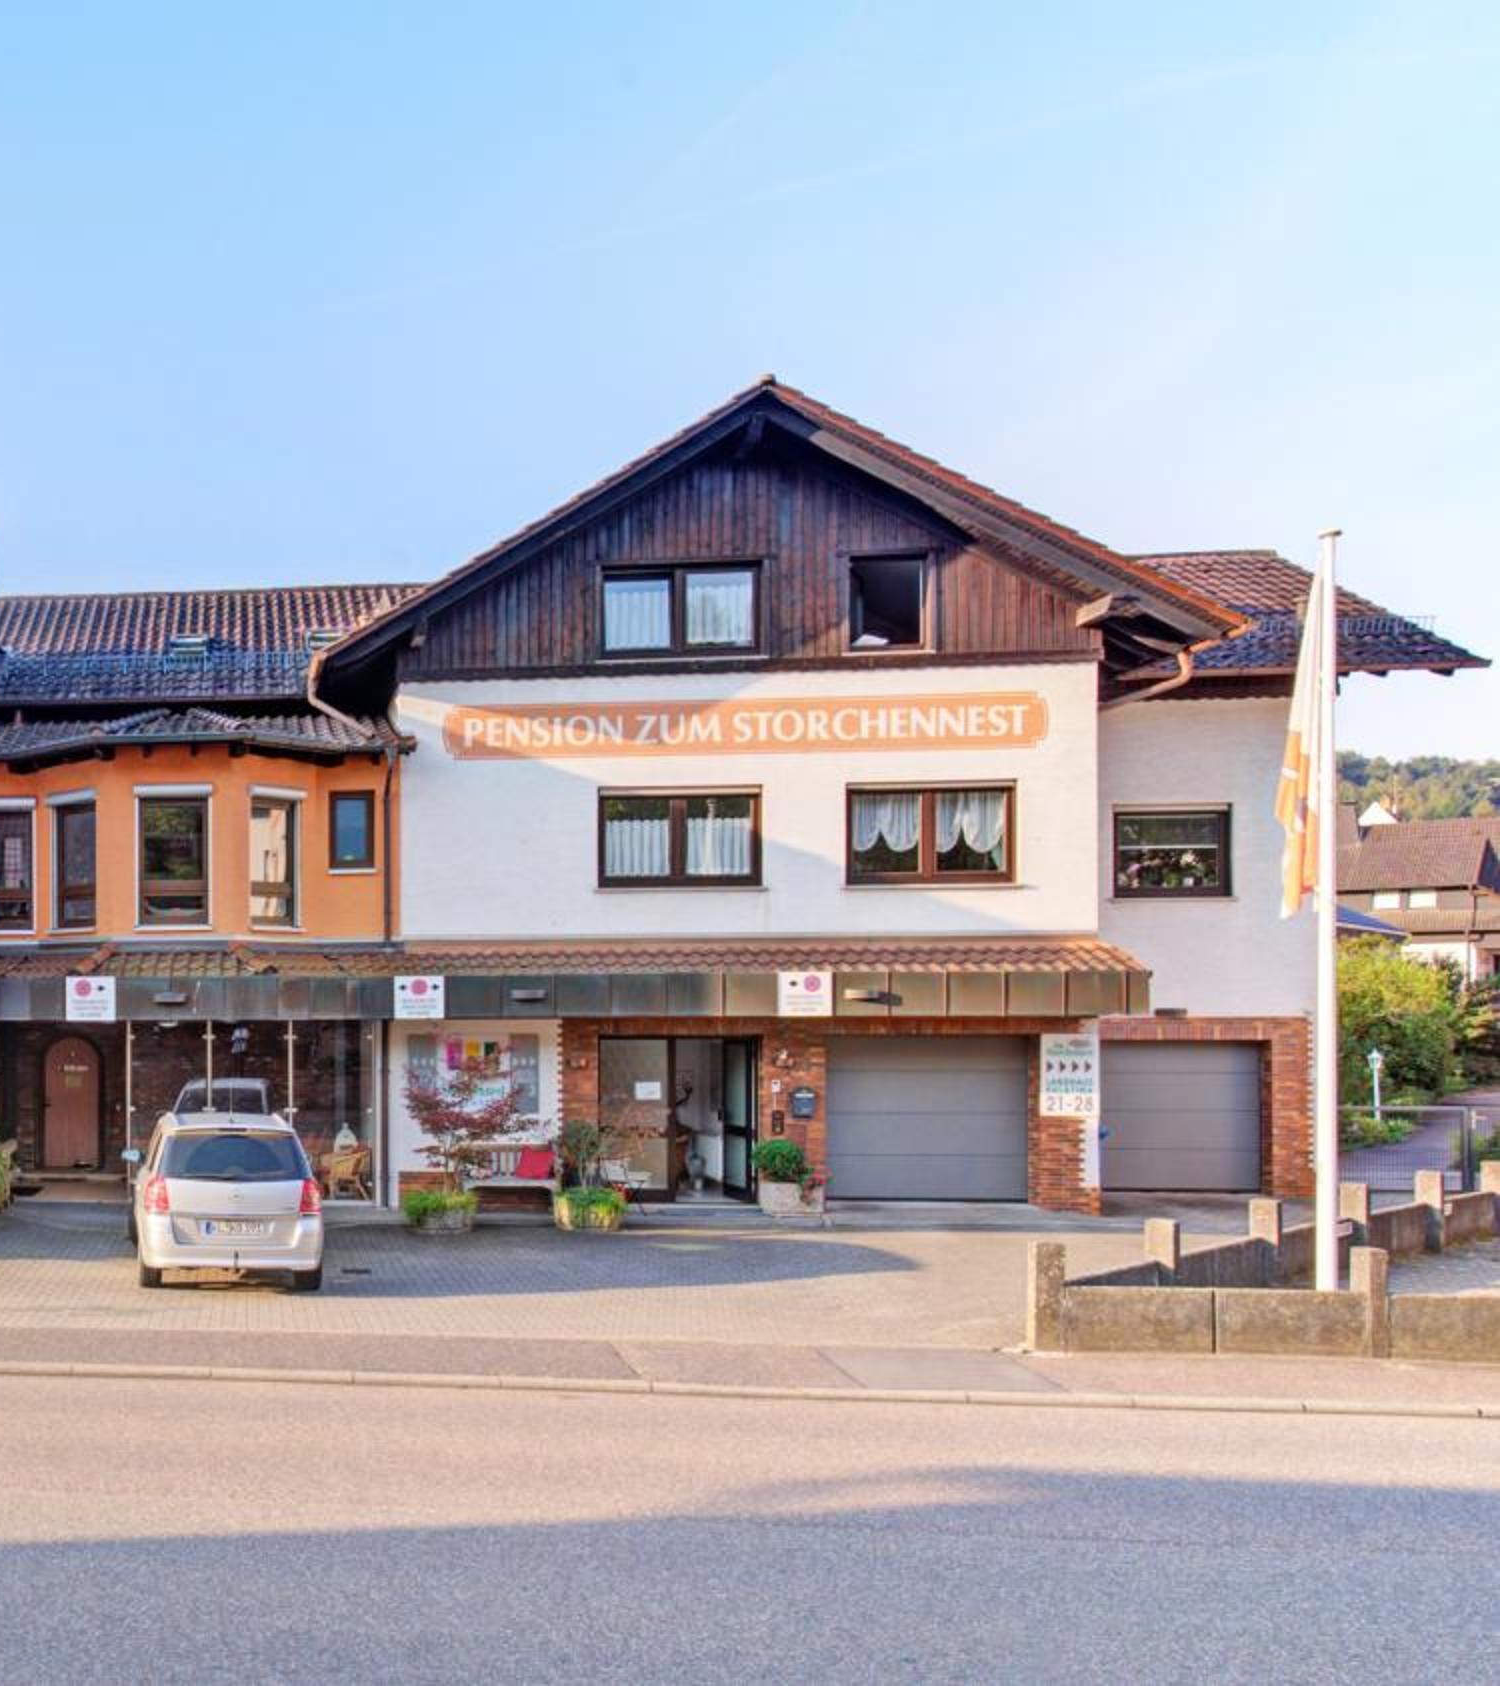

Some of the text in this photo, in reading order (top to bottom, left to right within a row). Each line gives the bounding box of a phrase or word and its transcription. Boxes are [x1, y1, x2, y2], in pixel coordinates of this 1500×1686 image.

[463, 703, 1029, 748] PENSION ZUM STORCHENNEST
